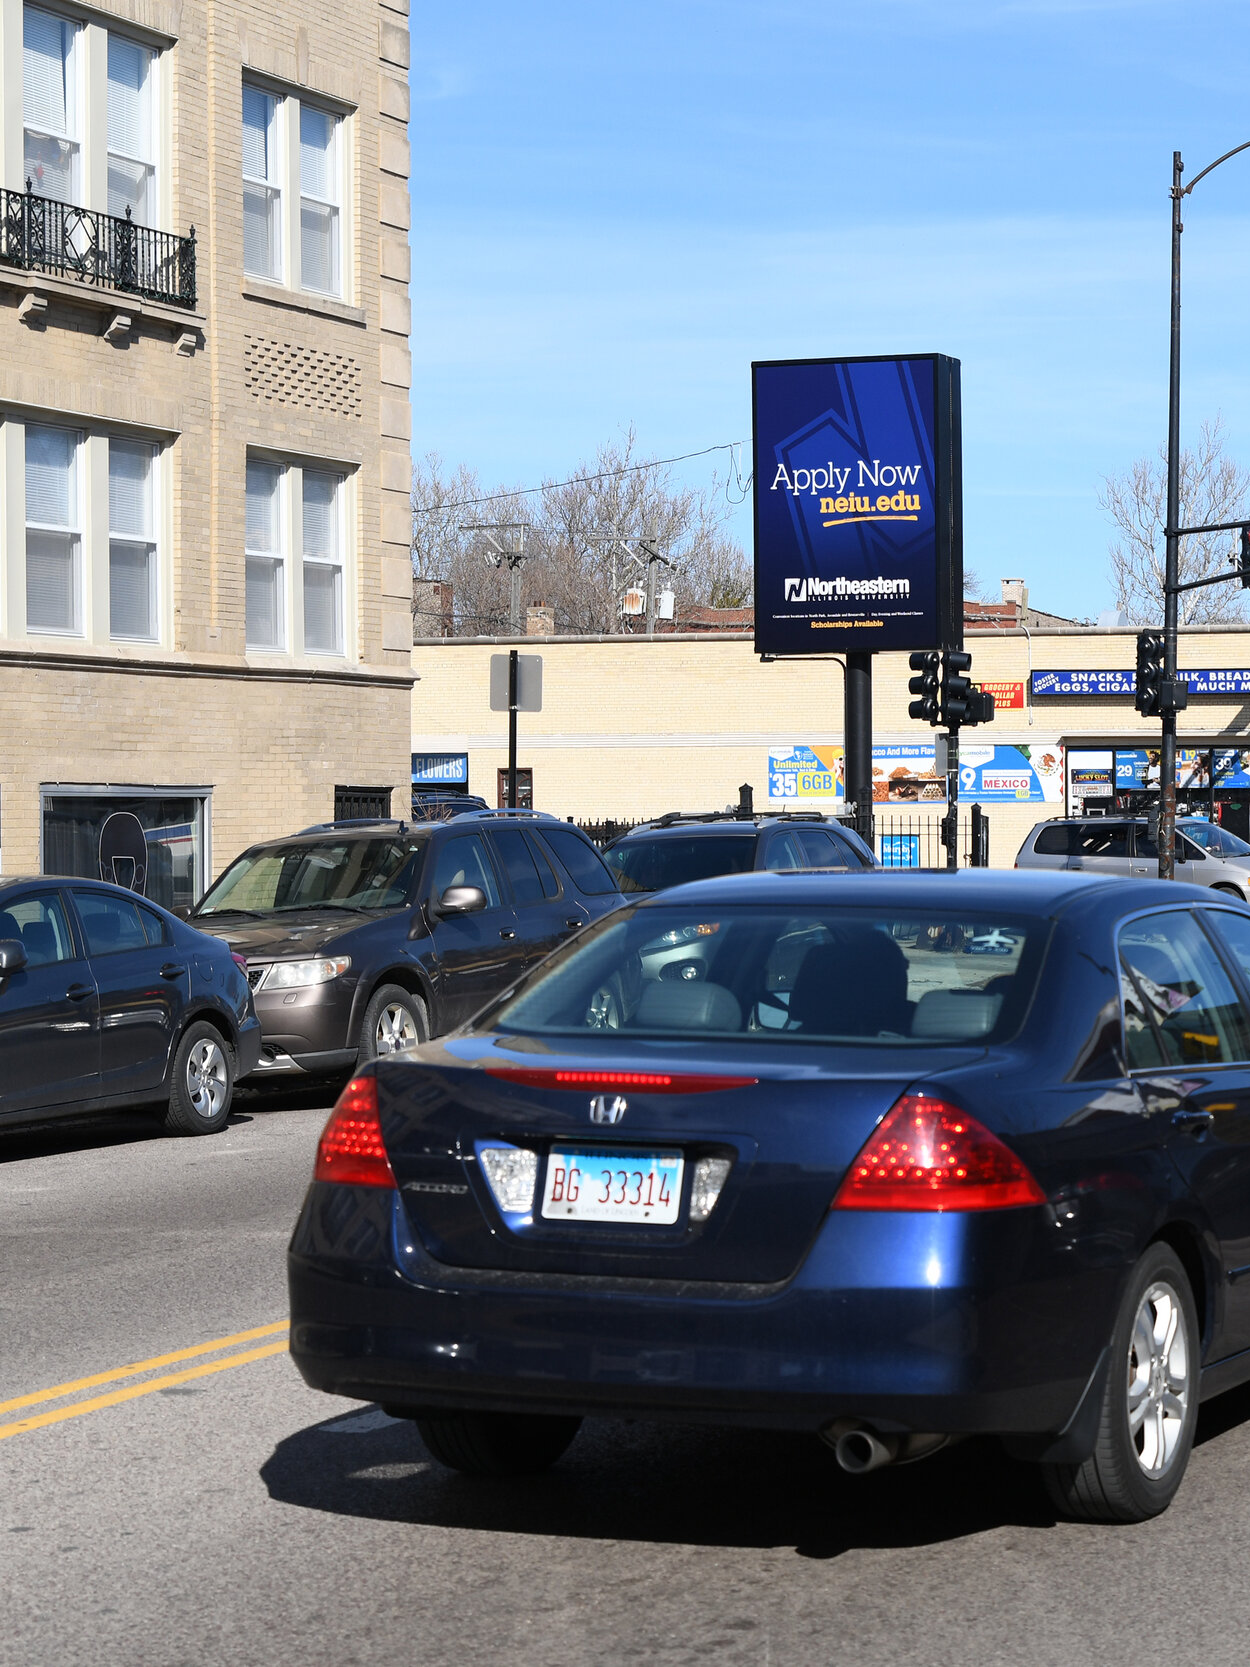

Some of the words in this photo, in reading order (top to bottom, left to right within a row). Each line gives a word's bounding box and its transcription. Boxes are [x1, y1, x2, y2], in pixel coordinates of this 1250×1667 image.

[770, 461, 851, 496] Apply
[857, 459, 922, 487] Now
[819, 490, 921, 513] neiu.edu
[807, 576, 910, 596] Northeastern
[811, 620, 853, 628] Scholarships
[853, 619, 884, 628] Available
[1035, 673, 1055, 687] FOSTER
[1070, 672, 1127, 683] SNACKS,
[980, 683, 1014, 691] GROCERY
[1014, 683, 1021, 691] &
[1034, 676, 1060, 693] GROCERY
[1054, 682, 1094, 693] EGGS,
[1196, 682, 1236, 691] MUCH
[887, 747, 900, 756] And
[901, 747, 919, 756] More
[956, 747, 991, 757] ycamobile
[416, 757, 463, 779] FLOWERS
[773, 759, 818, 769] Unlimited
[802, 774, 832, 790] 6GB
[983, 777, 1028, 788] MÉXICO
[551, 1167, 581, 1202] BG
[597, 1169, 670, 1207] 33314
